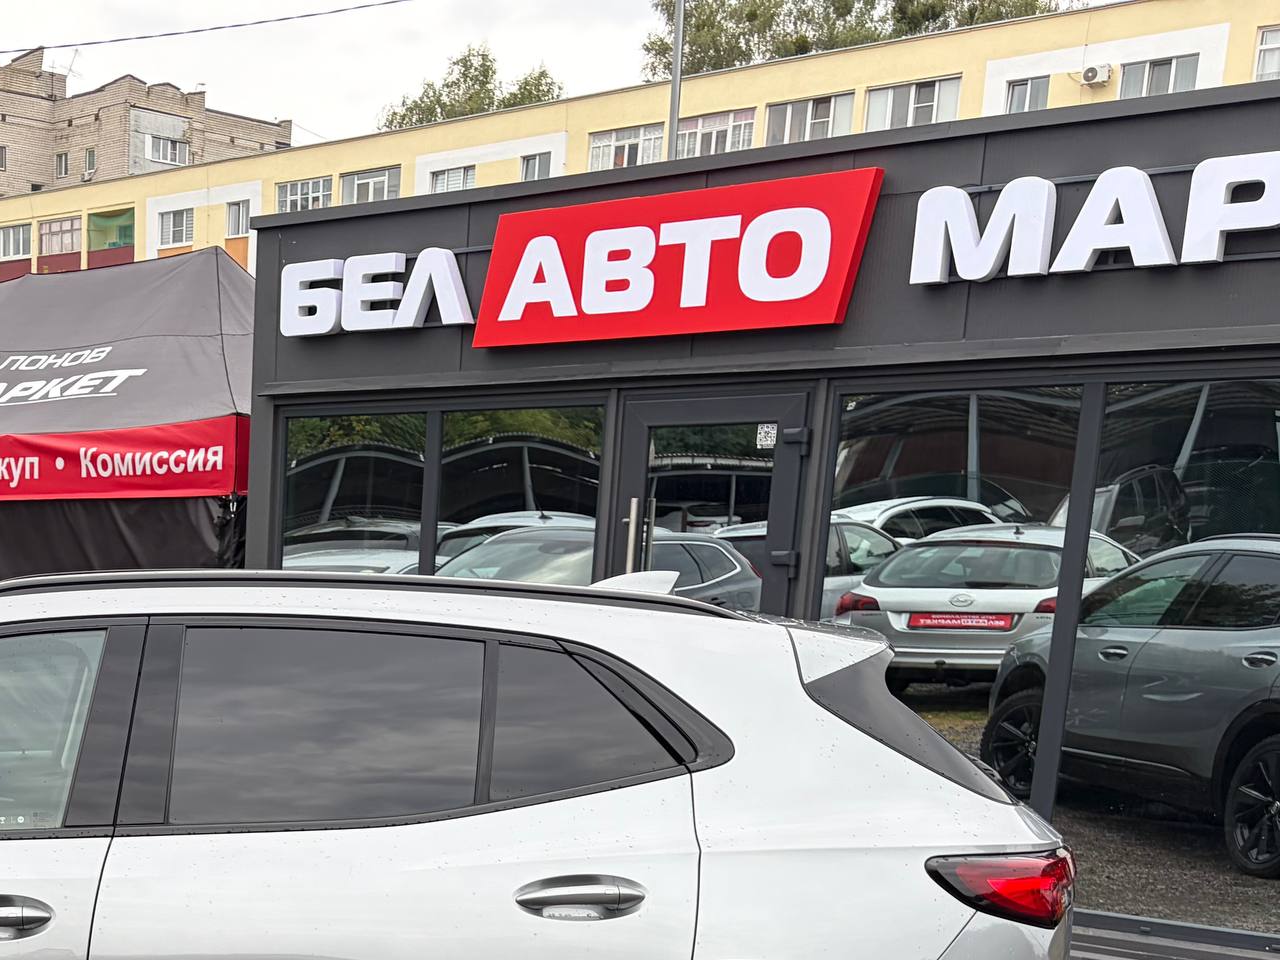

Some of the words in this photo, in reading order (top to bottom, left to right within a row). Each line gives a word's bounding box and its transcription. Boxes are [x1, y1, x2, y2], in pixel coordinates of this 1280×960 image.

[280, 247, 475, 337] БЕЛ
[497, 207, 832, 322] АВТО
[909, 151, 1280, 285] МАР
[79, 445, 224, 478] Комиссия
